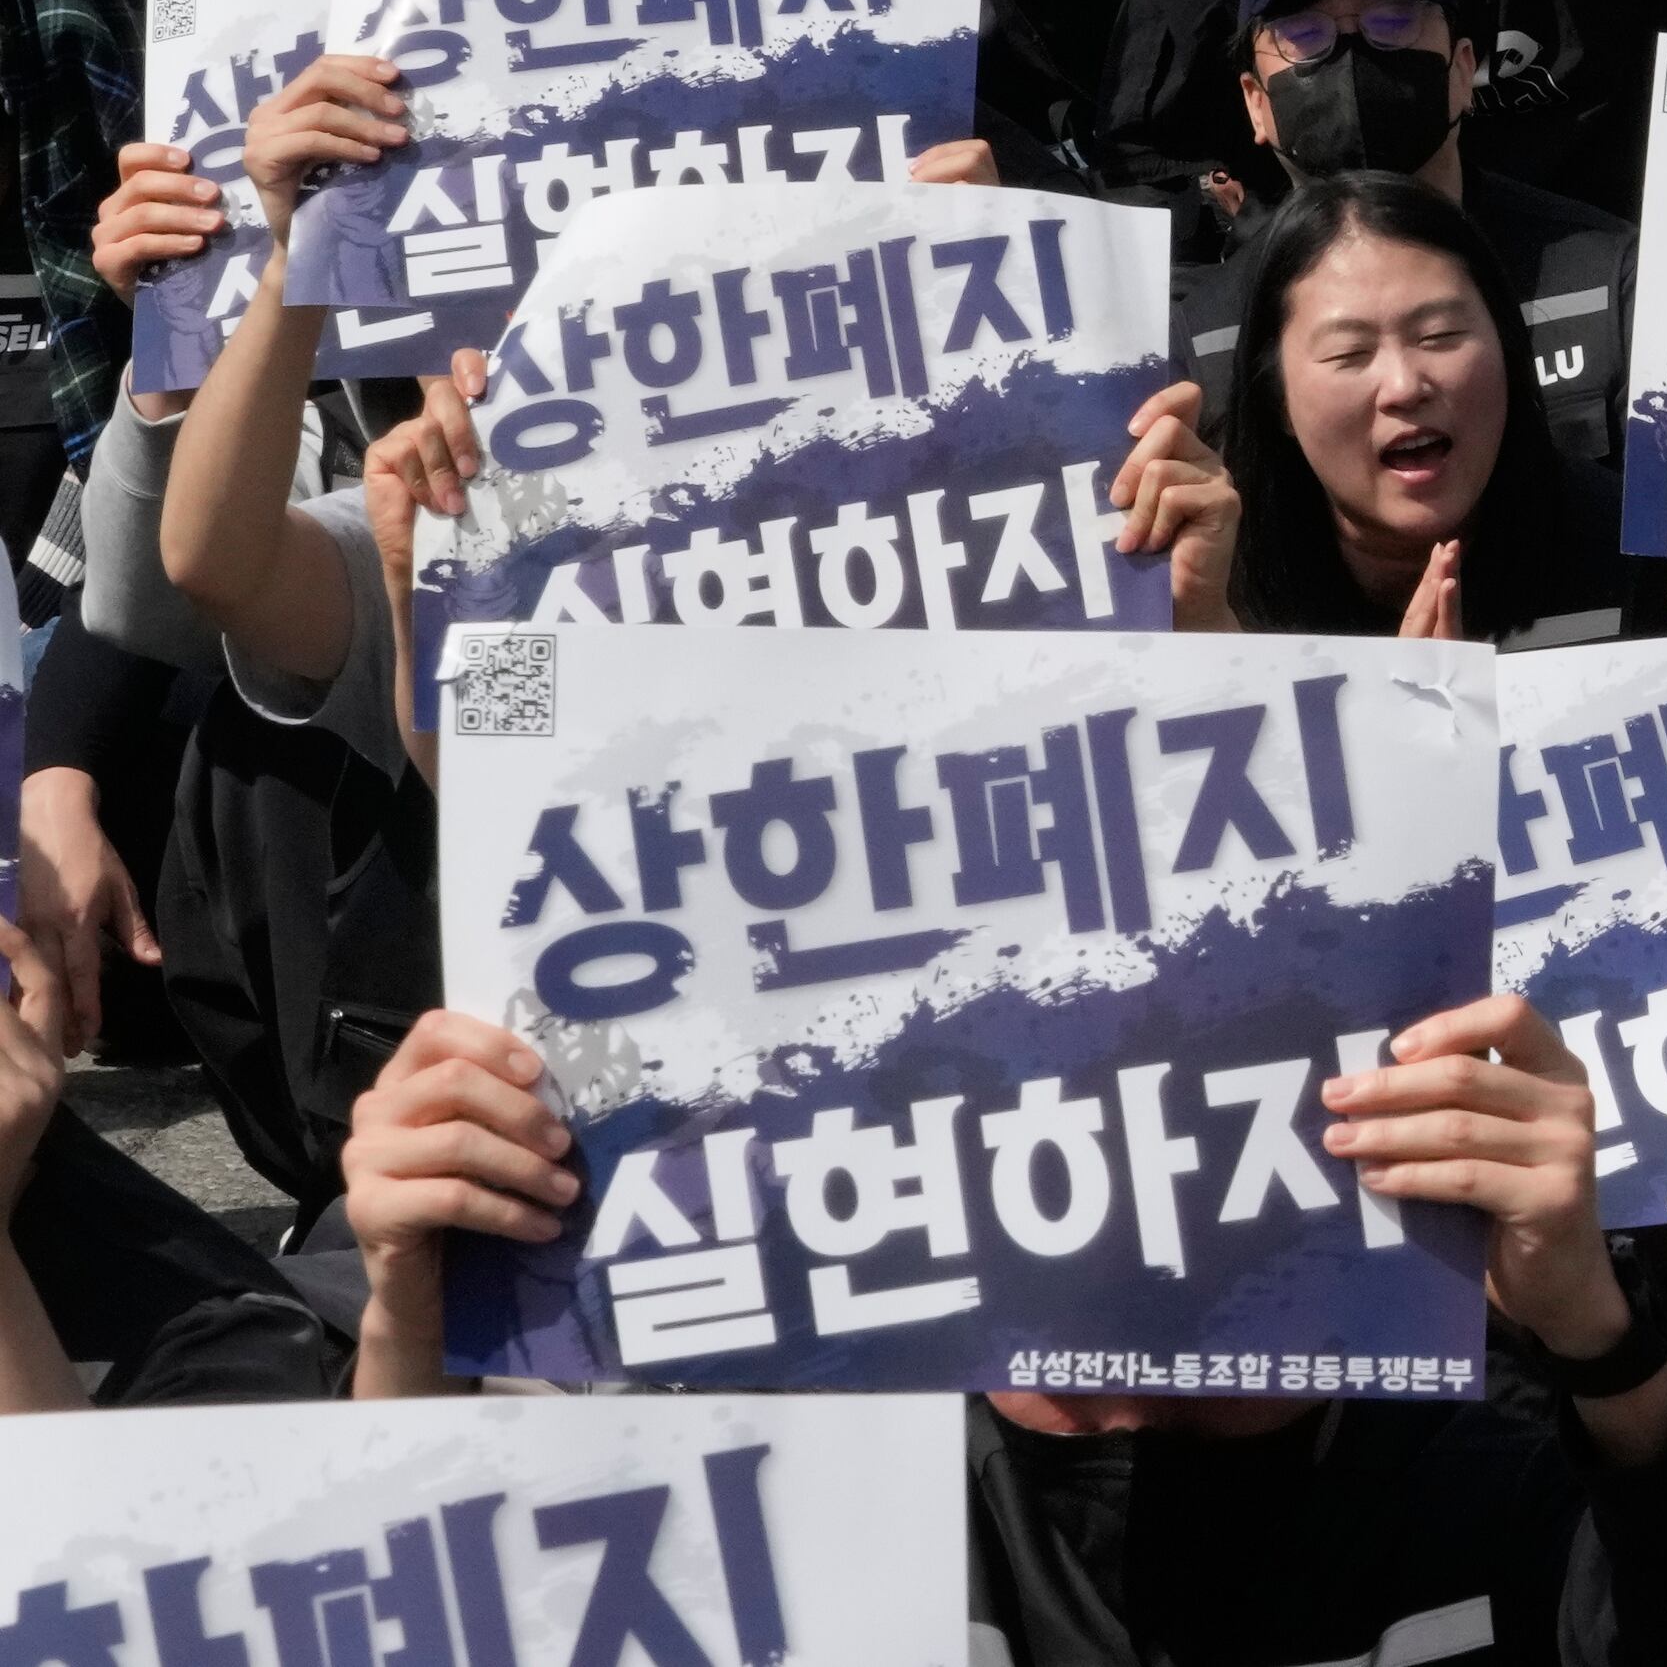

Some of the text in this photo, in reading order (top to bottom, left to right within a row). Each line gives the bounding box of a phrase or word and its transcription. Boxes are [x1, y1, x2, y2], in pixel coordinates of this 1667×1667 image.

[480, 221, 1073, 471] 상한폐지
[502, 674, 1356, 1024] 상한폐지
[588, 1028, 1404, 1366] 실현하자
[1008, 1351, 1474, 1393] 삼성전자노동조합 공동투쟁본부
